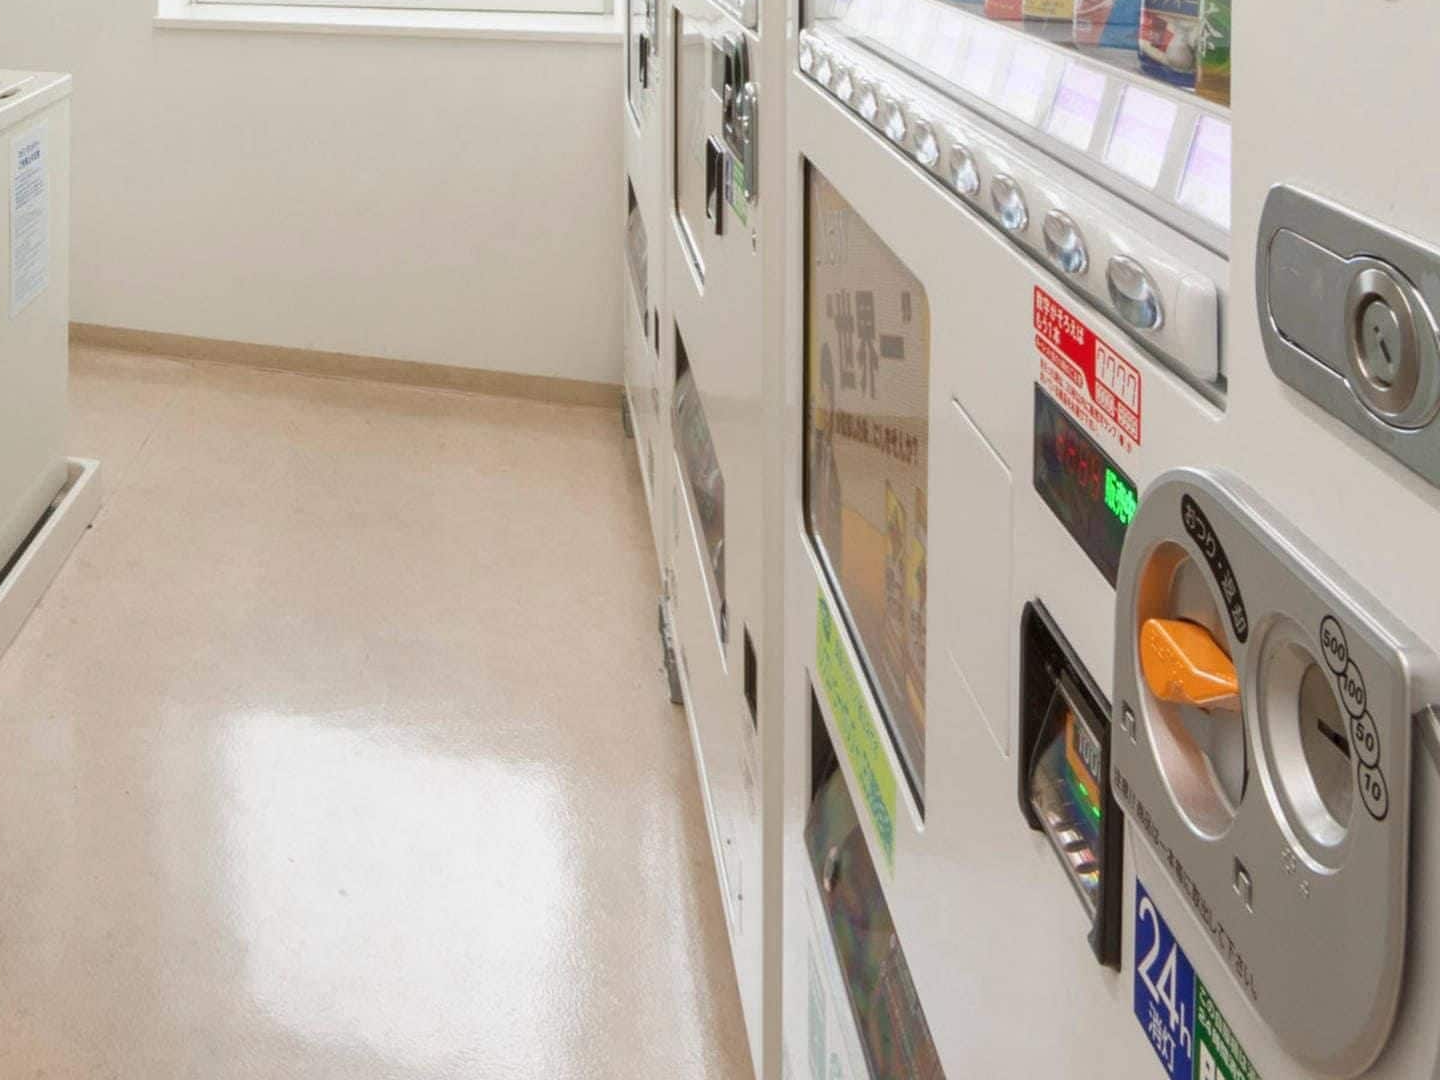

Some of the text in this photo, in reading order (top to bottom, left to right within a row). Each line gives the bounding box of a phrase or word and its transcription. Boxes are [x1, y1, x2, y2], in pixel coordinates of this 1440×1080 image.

[1322, 629, 1348, 663] 500
[1344, 671, 1366, 708] 100
[1354, 723, 1377, 752] 50
[1363, 773, 1383, 802] 10
